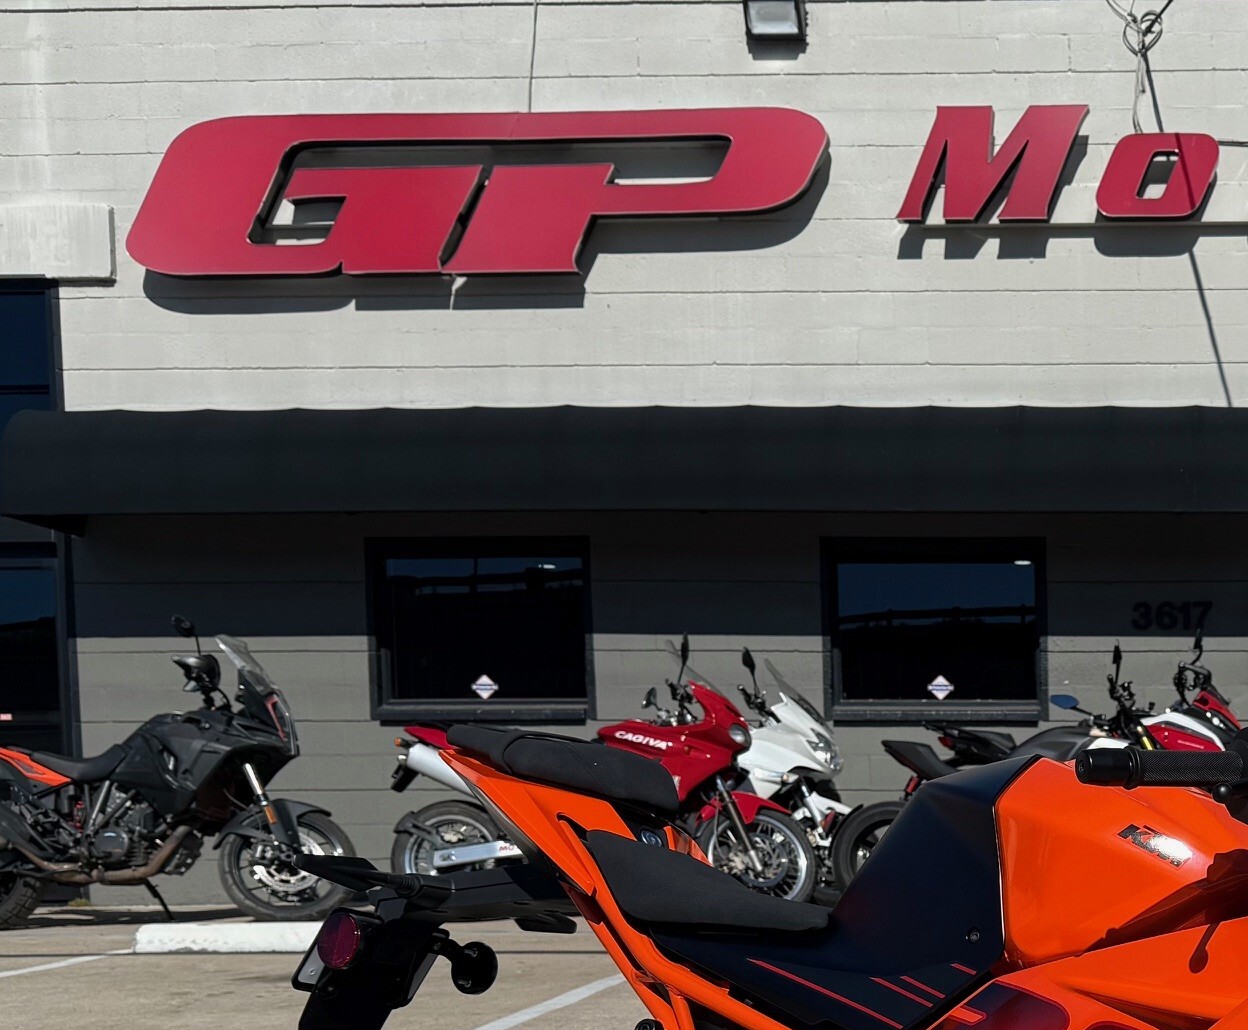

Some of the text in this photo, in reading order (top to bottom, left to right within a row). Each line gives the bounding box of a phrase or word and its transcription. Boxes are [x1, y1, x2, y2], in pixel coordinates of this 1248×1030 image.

[126, 107, 829, 276] GP
[1131, 600, 1213, 631] 3617
[614, 730, 668, 750] CAGIVA
